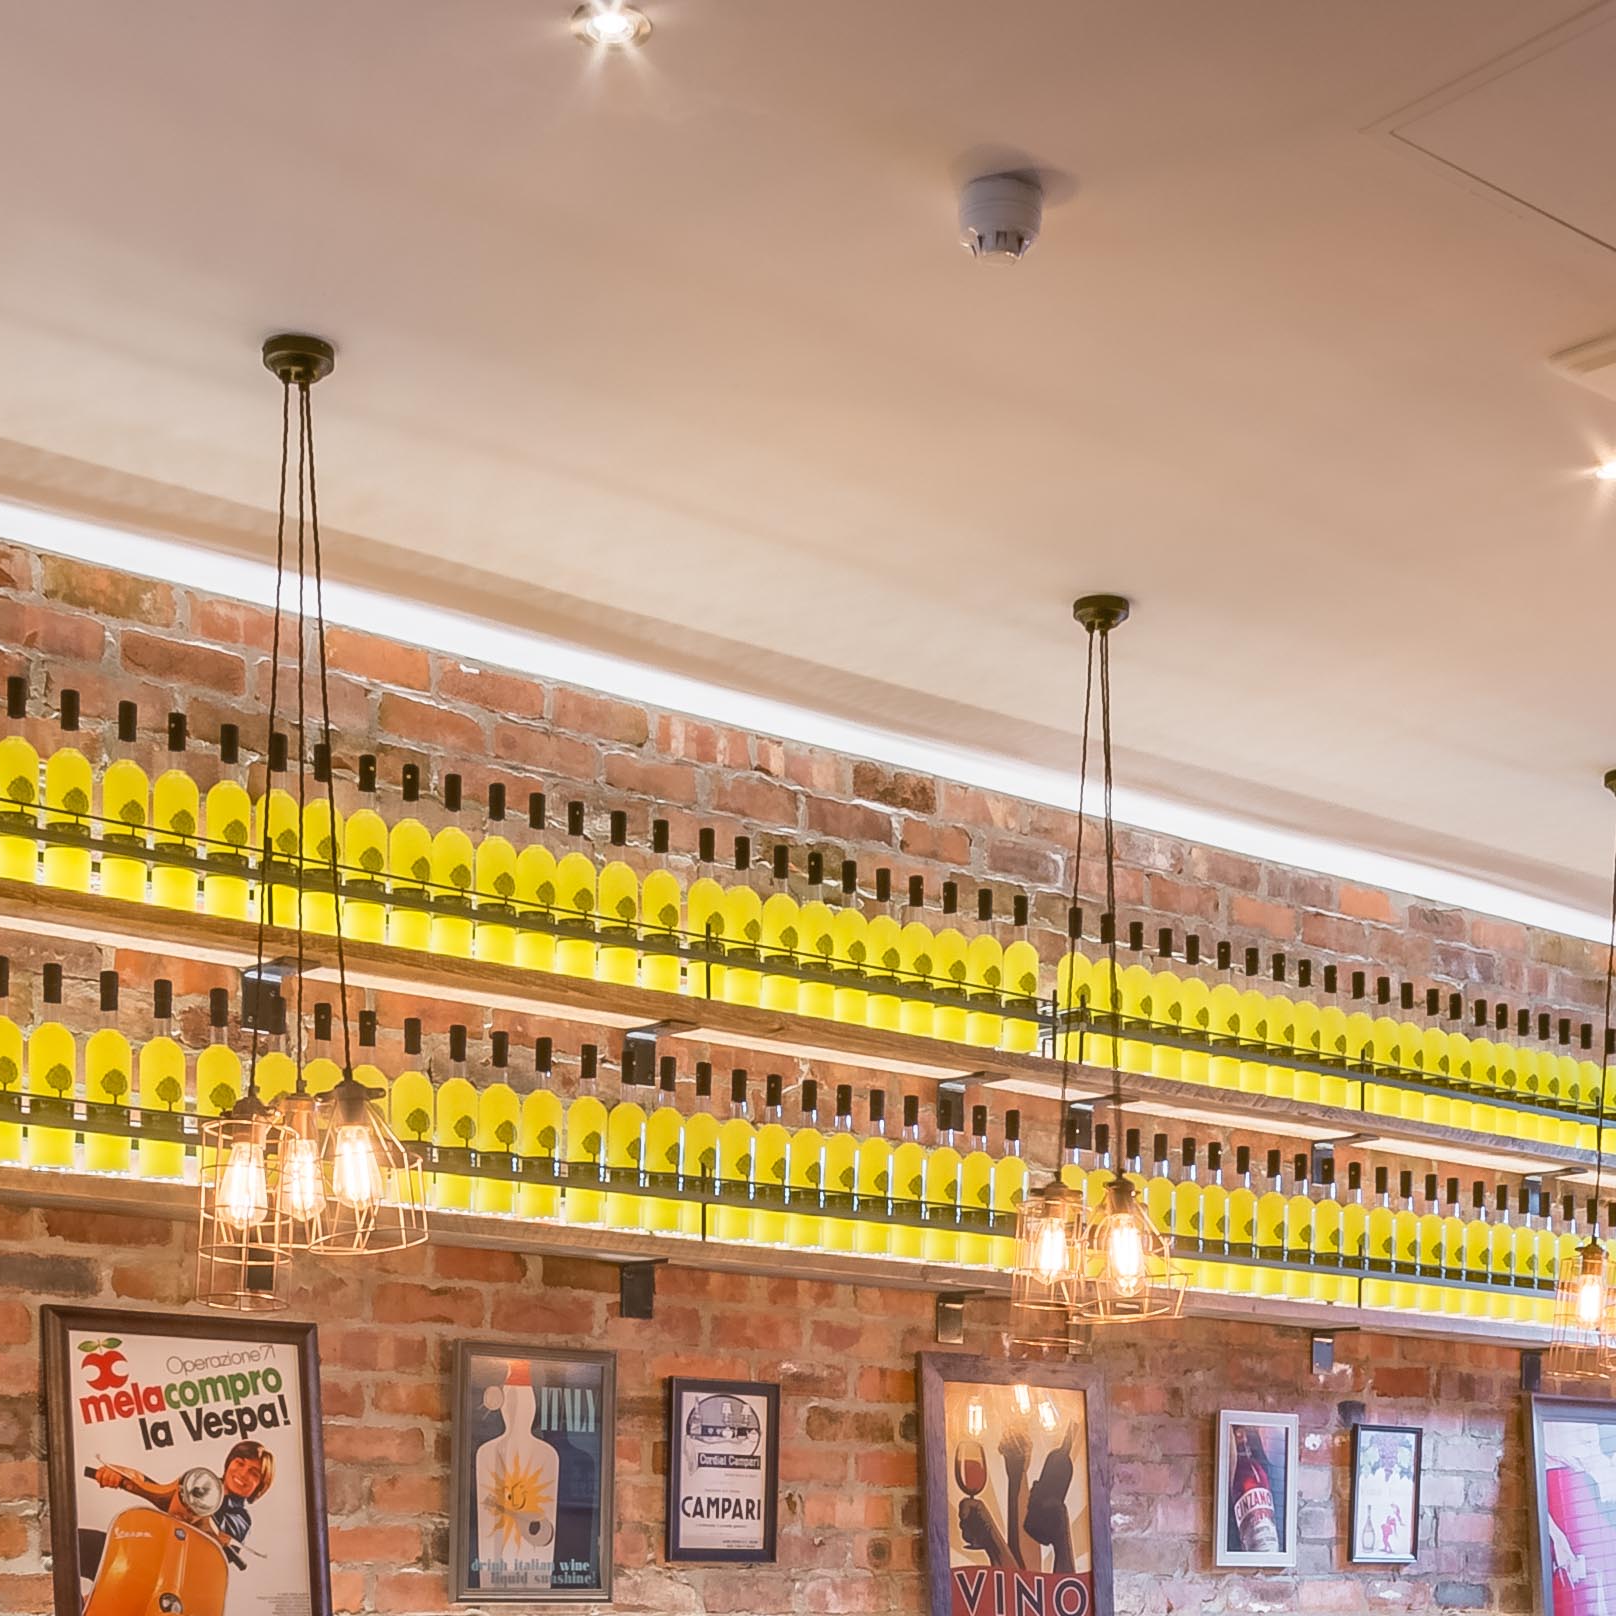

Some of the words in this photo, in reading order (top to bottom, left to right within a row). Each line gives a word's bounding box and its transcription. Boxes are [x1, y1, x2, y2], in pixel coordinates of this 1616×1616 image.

[166, 1349, 261, 1376] Operazione
[139, 1417, 174, 1450] la
[179, 1394, 291, 1442] Vespa!
[540, 1386, 596, 1433] ITALY
[699, 1453, 727, 1466] Cordial
[728, 1455, 760, 1467] Campari
[681, 1495, 761, 1520] CAMPARI
[513, 1558, 556, 1572] italian
[559, 1558, 590, 1572] wine
[490, 1572, 528, 1585] liquid
[534, 1571, 597, 1585] sunshine!
